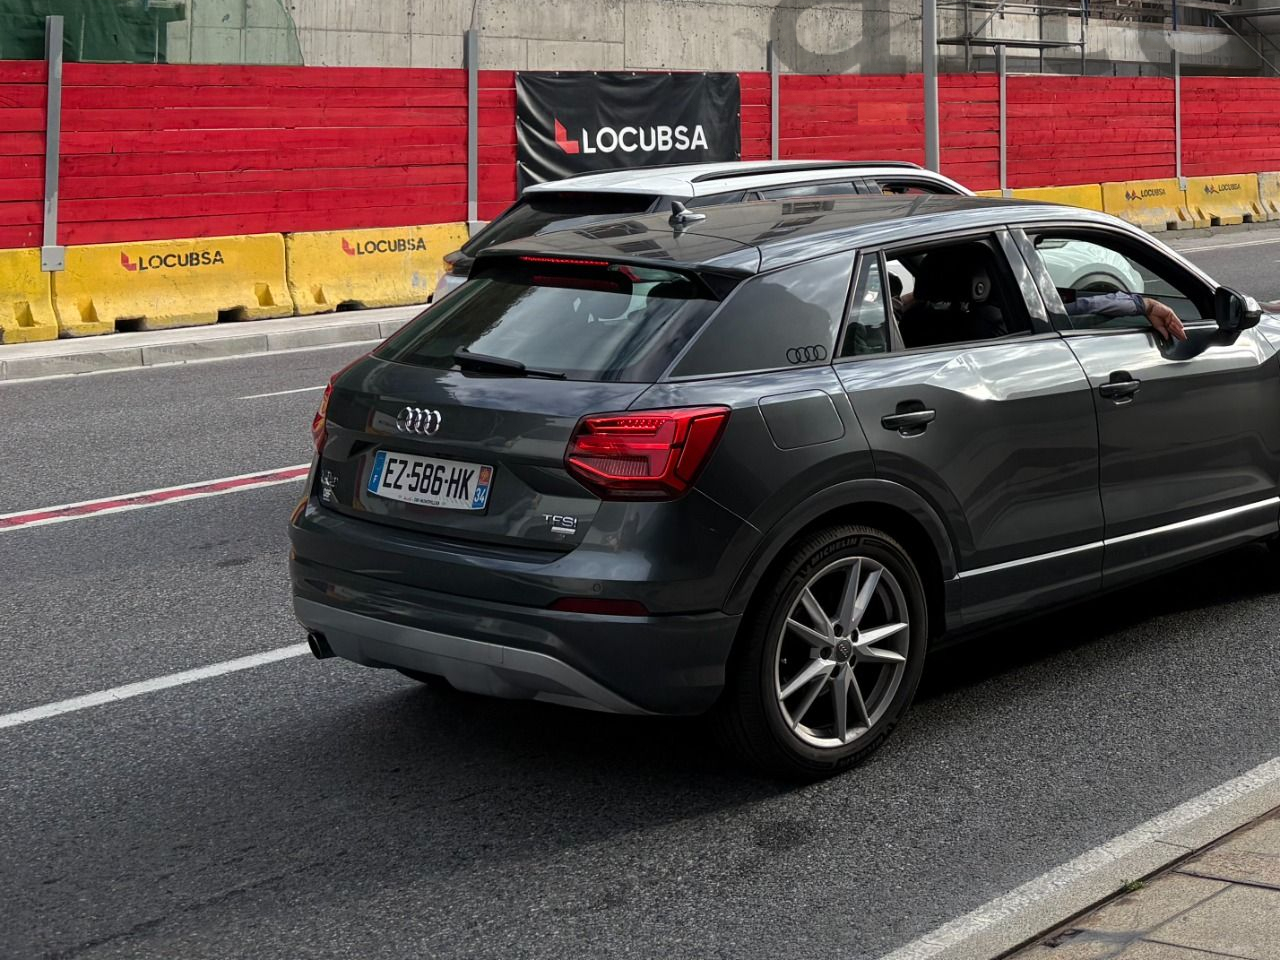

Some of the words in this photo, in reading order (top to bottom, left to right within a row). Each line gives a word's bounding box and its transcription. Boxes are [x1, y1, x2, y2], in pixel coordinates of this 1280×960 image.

[582, 125, 709, 154] LOCUBSA
[1140, 188, 1166, 199] LOCUBSA
[1218, 183, 1241, 192] LOCUBSA
[356, 237, 427, 256] LOCUBSA
[139, 250, 225, 271] LOCUBSA
[382, 458, 476, 501] EZ-586-HK
[473, 486, 487, 505] 34
